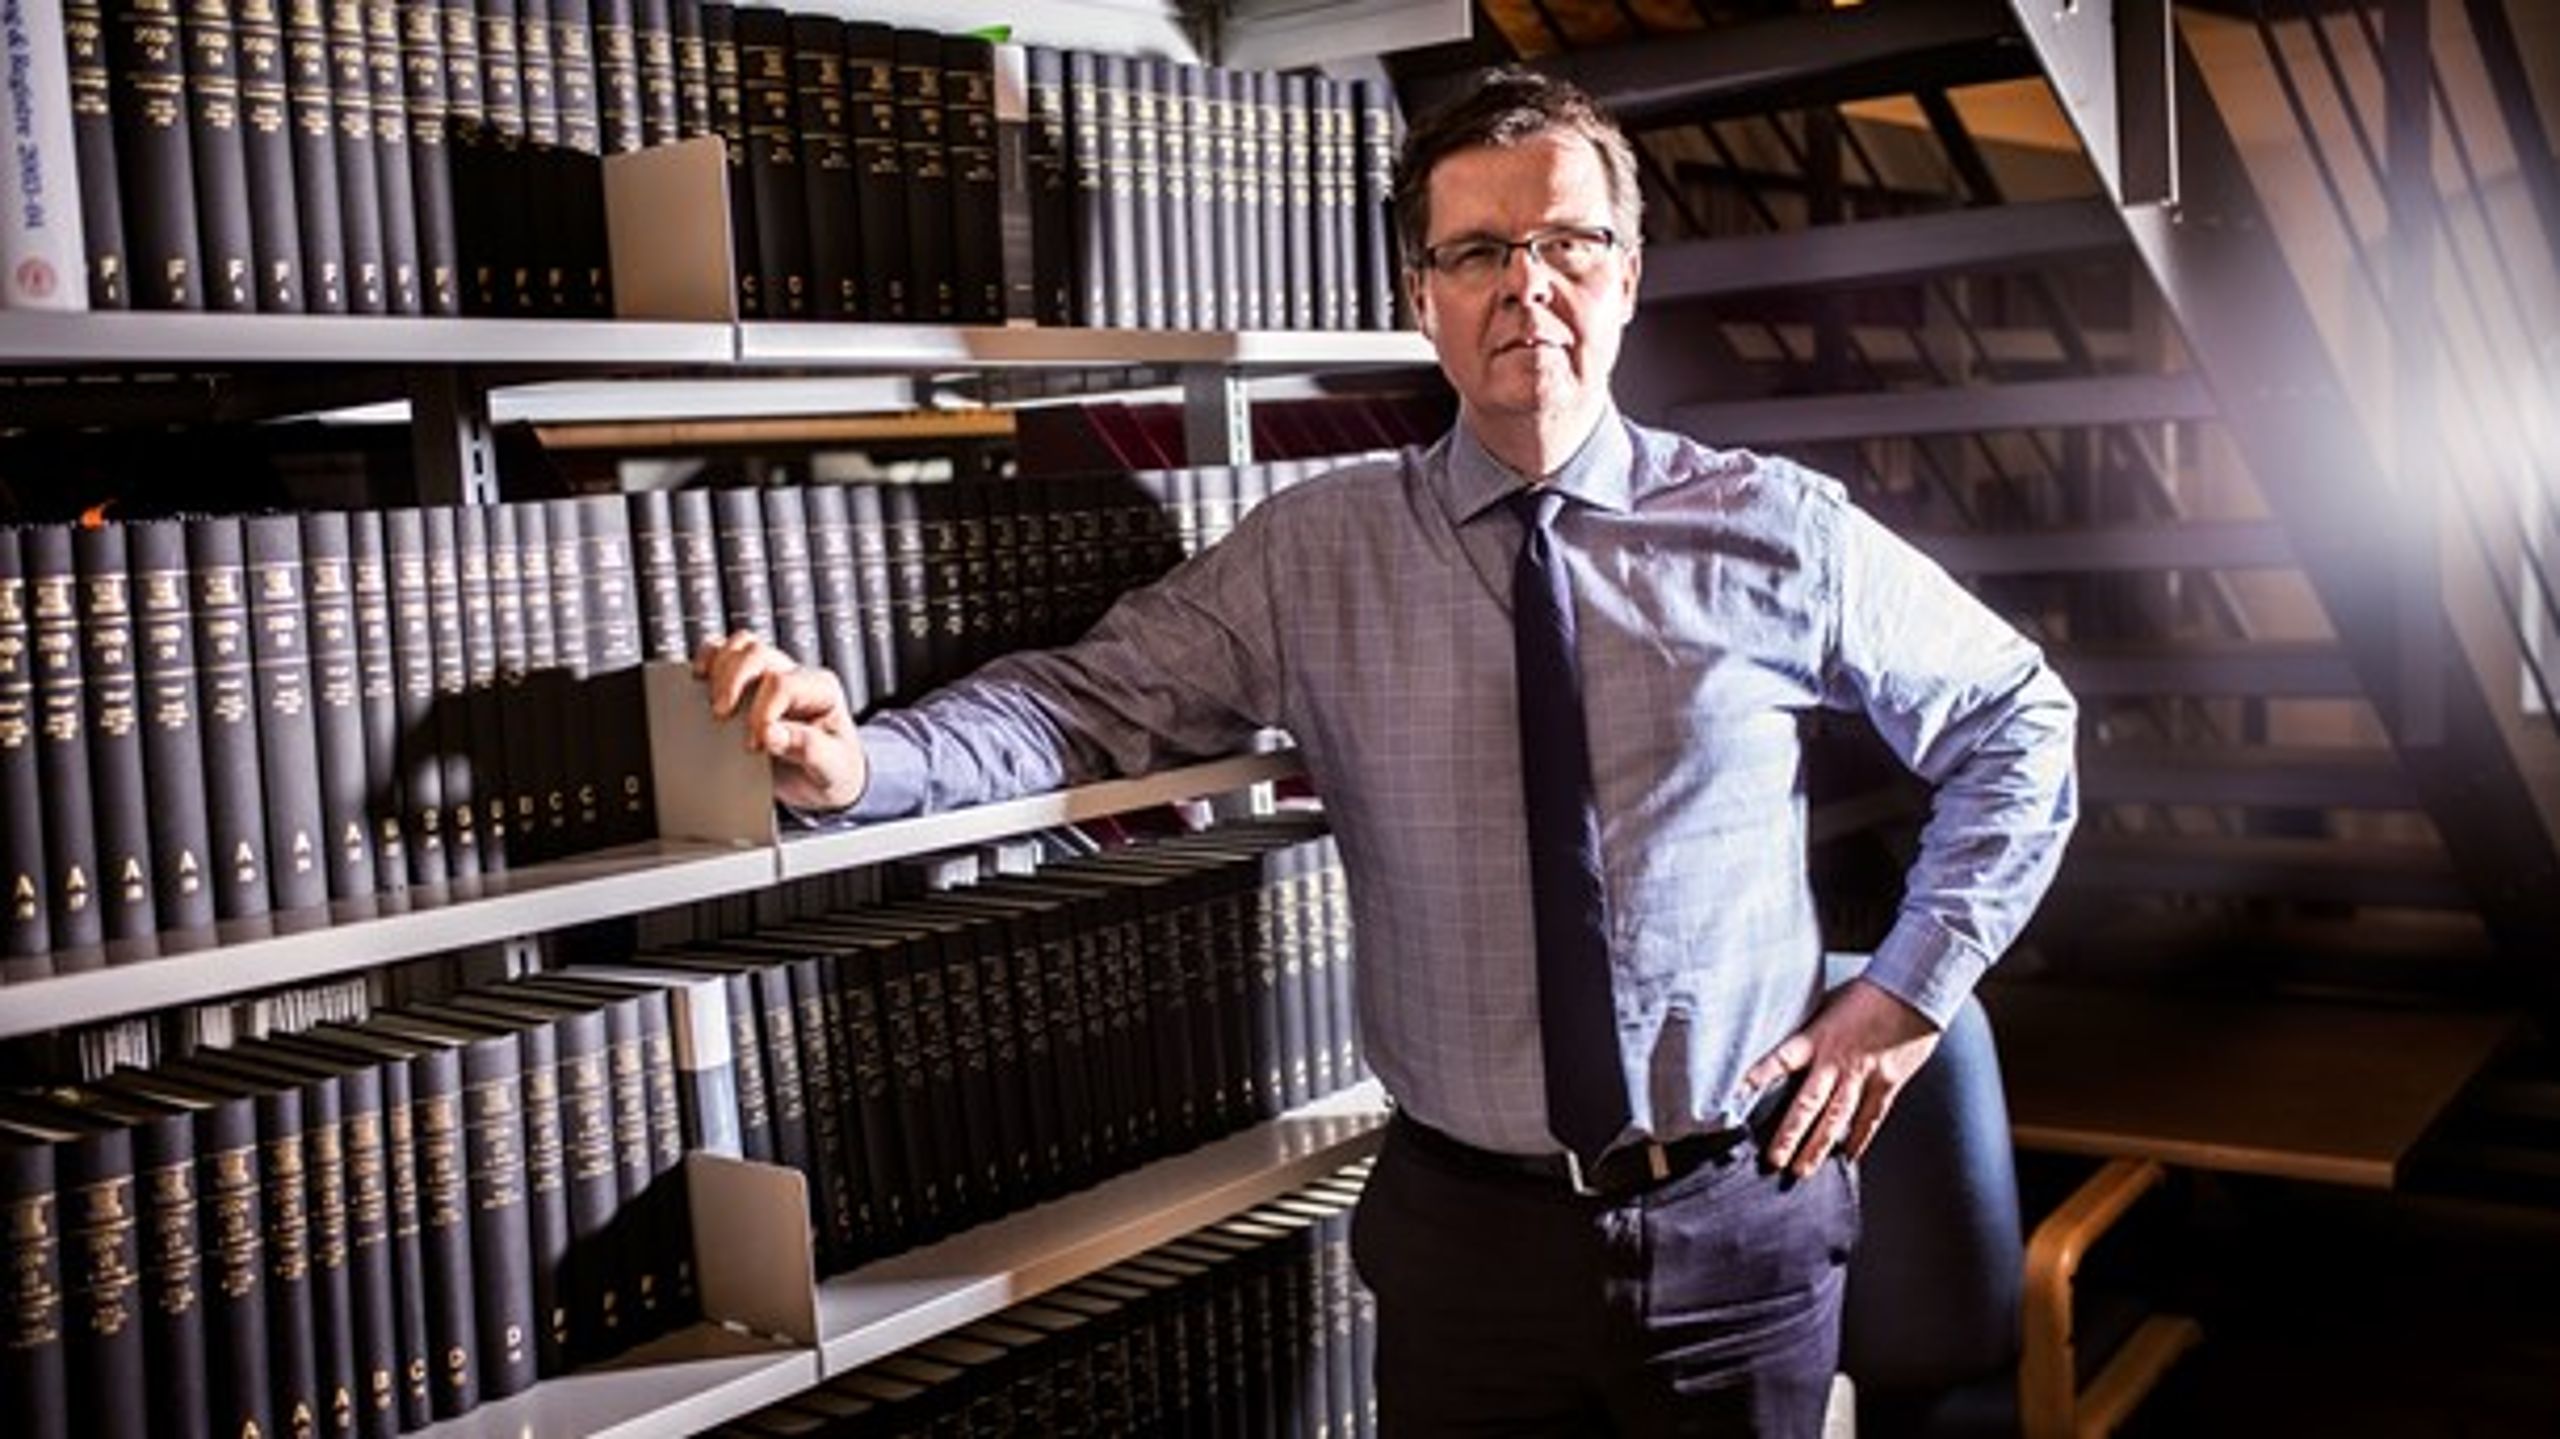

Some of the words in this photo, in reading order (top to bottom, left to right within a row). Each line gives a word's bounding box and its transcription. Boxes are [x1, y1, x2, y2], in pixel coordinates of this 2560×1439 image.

[167, 258, 187, 283] F
[229, 258, 244, 283] F
[294, 830, 311, 854] A
[344, 821, 362, 844] A
[179, 850, 198, 873] A
[236, 841, 254, 862] A
[66, 865, 87, 890] A
[124, 857, 142, 881] A
[16, 873, 35, 898] A
